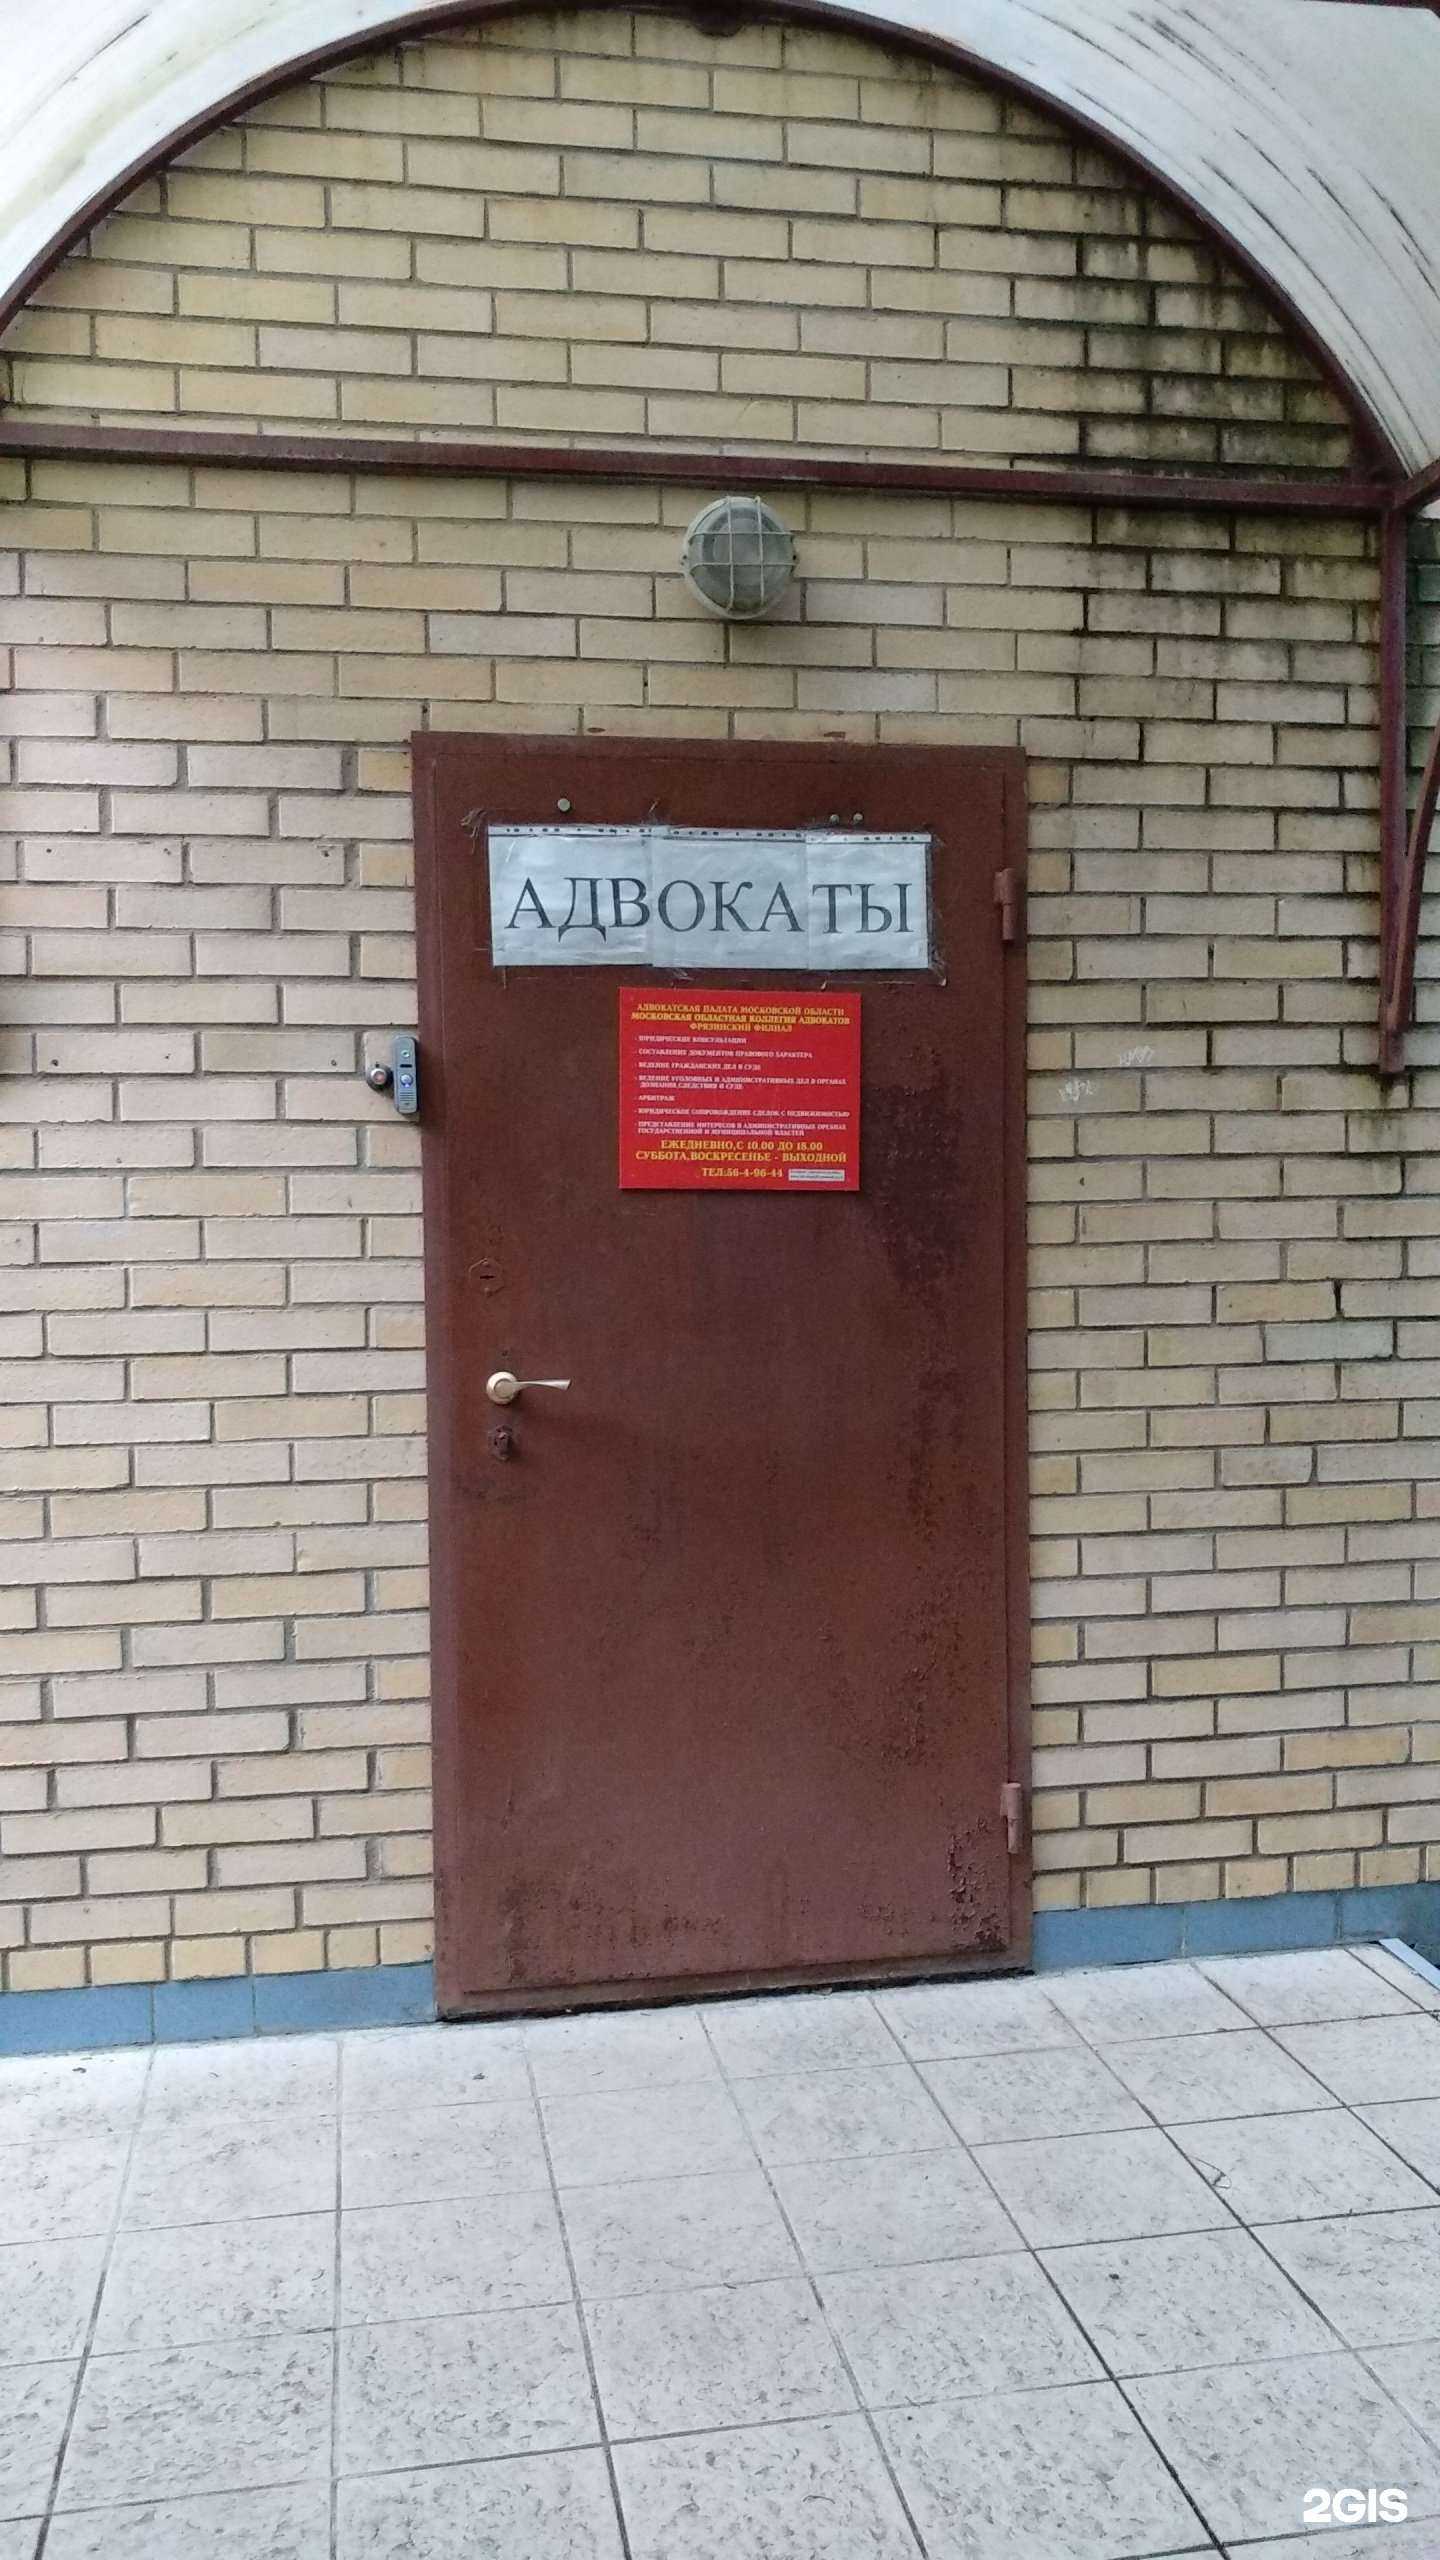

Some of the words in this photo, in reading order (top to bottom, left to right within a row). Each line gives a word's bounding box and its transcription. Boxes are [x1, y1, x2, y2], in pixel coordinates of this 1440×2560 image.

[504, 877, 912, 942] АДВОКАТЫ
[637, 1003, 701, 1013] АДВОКАТСКАЯ
[703, 1004, 738, 1013] ПАЛАТА
[741, 1006, 801, 1015] МОСКОВСКОЙ
[803, 1007, 845, 1016] ОБЛАСТИ
[631, 1012, 692, 1021] МОСКОВСКАЯ
[694, 1013, 747, 1022] ОБЛАСТНАЯ
[749, 1015, 797, 1024] КОЛЛЕГИЯ
[799, 1016, 850, 1025] АДВОКАТОВ
[689, 1023, 751, 1032] ФРЯЗИНСКИЙ
[753, 1024, 793, 1033] ФИЛИАЛ
[747, 1141, 775, 1150] 10.00
[777, 1141, 793, 1151] ДО
[797, 1141, 824, 1151] 18.00
[782, 1152, 847, 1163] ВЫХОДНОЙ
